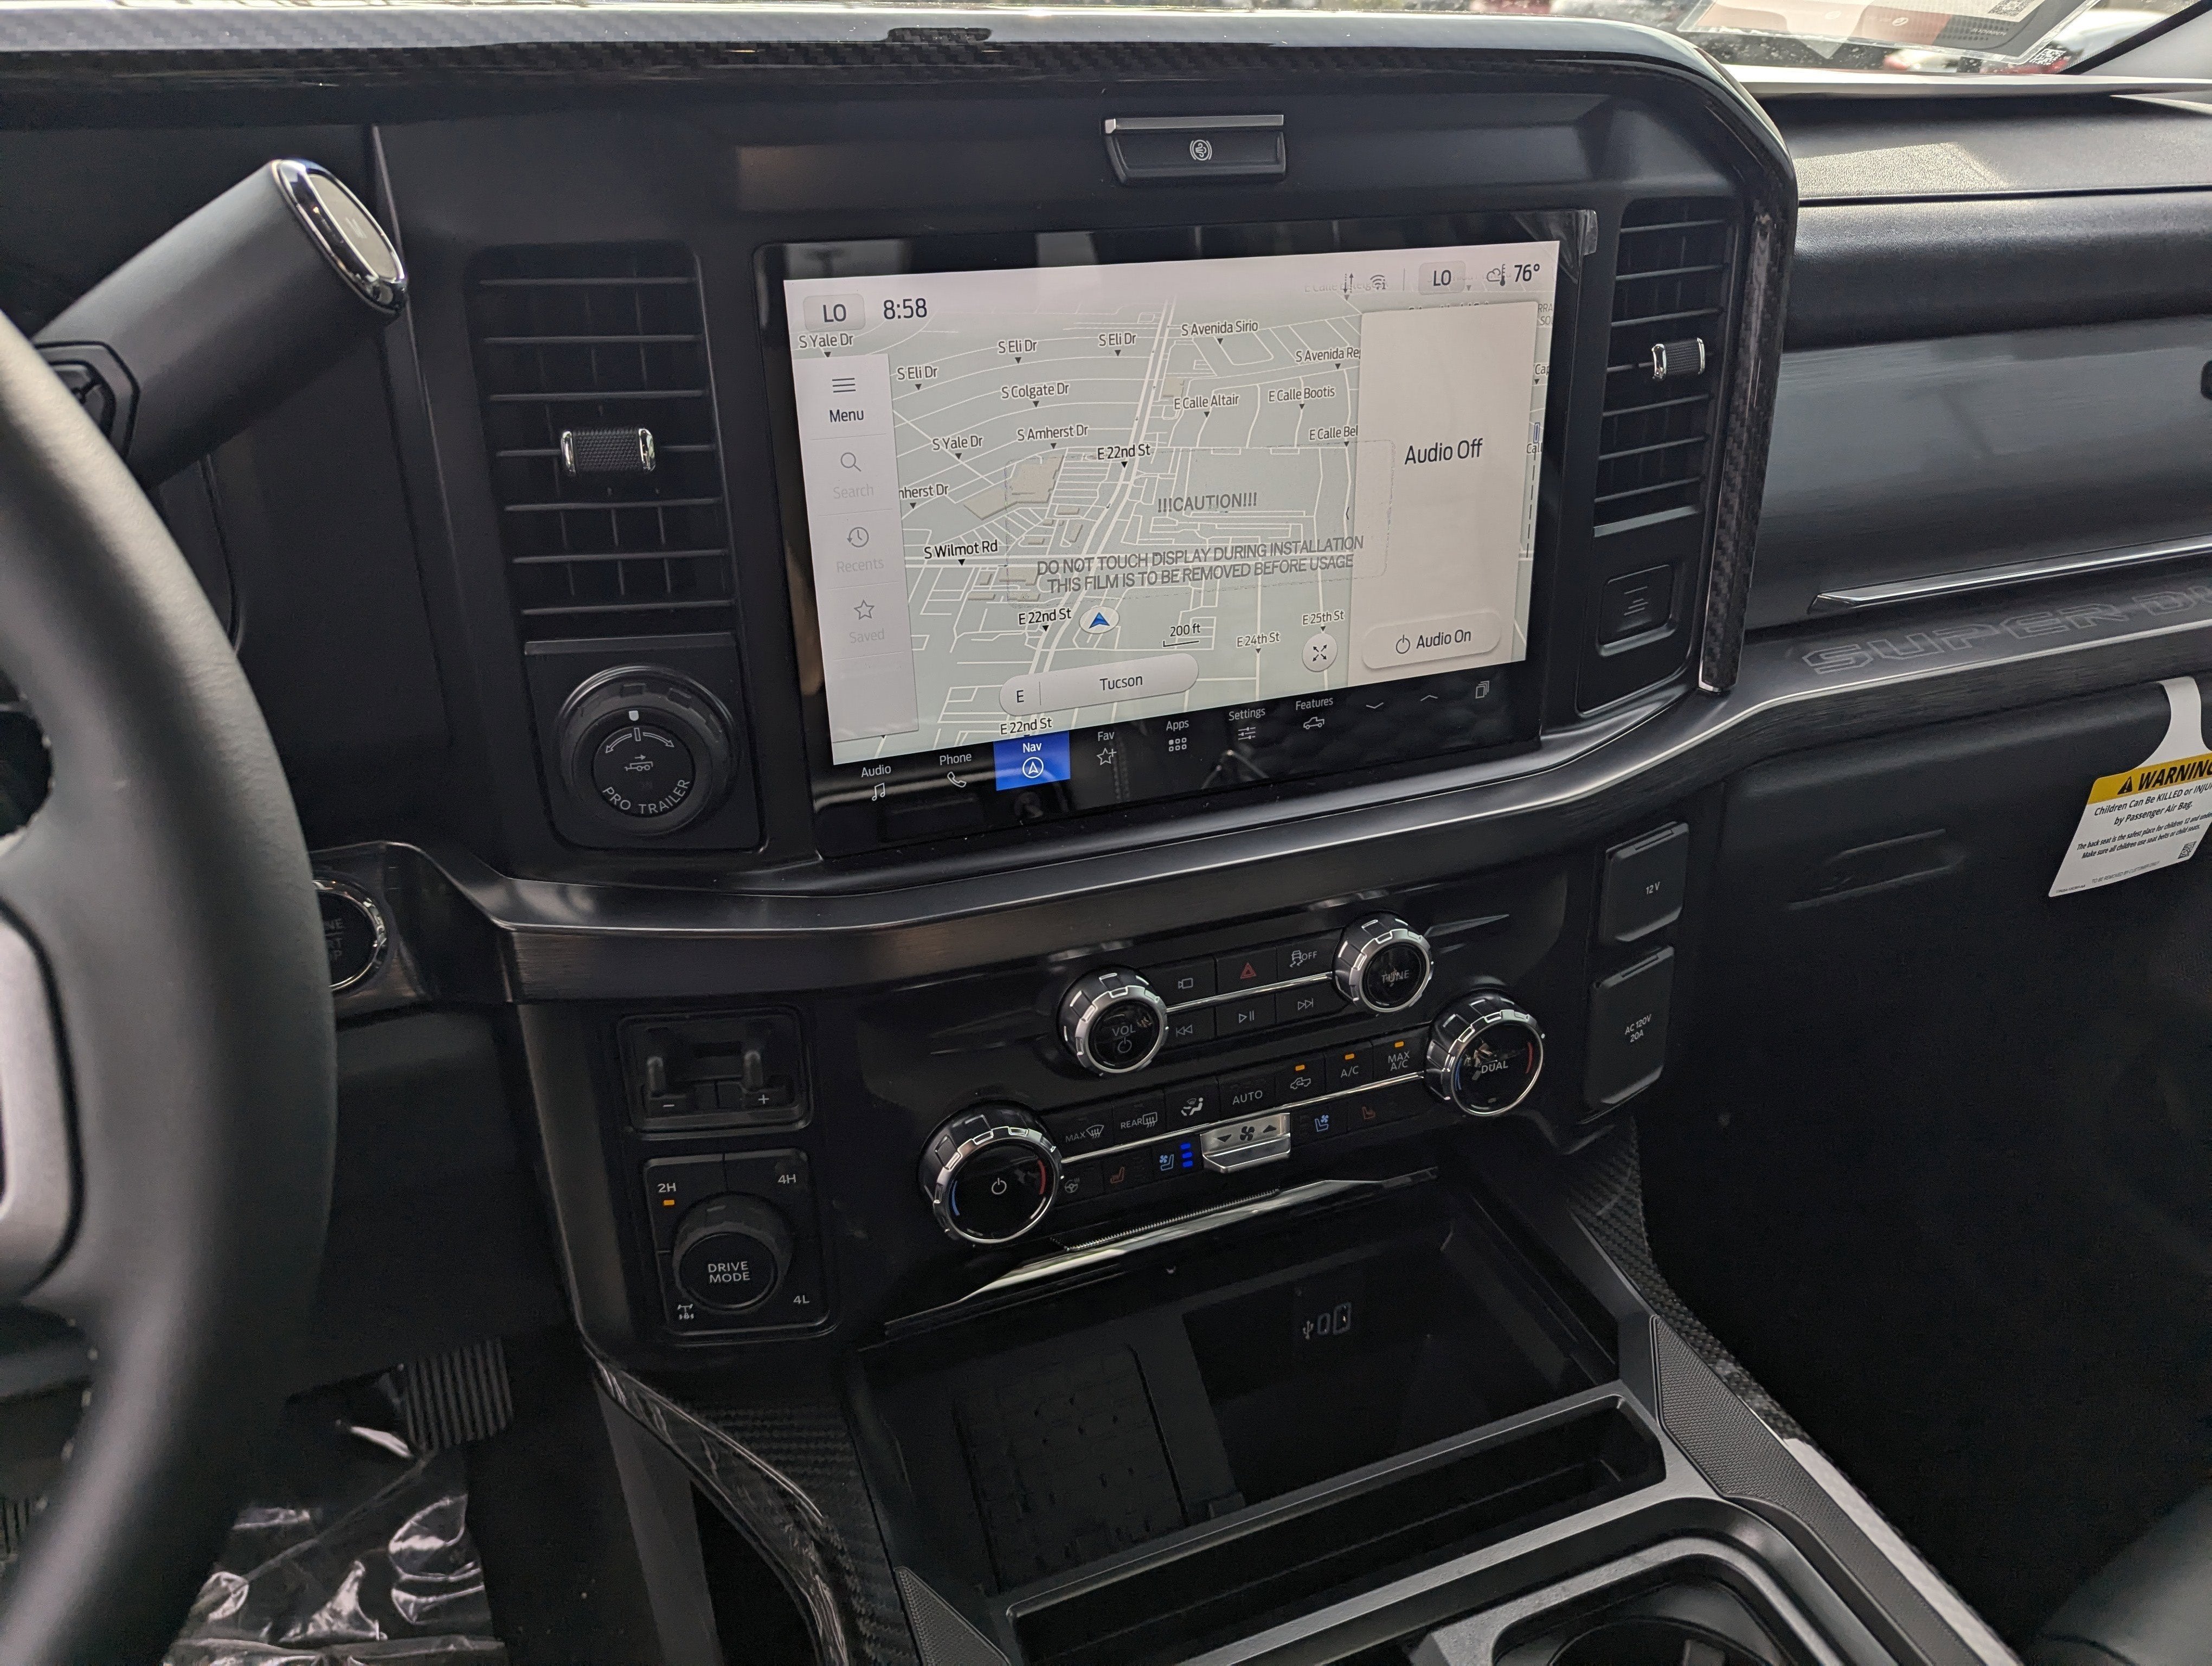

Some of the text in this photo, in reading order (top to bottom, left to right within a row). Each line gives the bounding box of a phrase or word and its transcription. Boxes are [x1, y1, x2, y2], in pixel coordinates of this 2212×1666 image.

[1433, 270, 1451, 286] LO
[824, 298, 927, 322] LO 8:58
[1181, 320, 1258, 336] S Avenida Sirio
[799, 334, 853, 348] S Yale Dr
[998, 339, 1037, 353] S Eli Dr
[1099, 332, 1136, 346] S Eli Dr
[1296, 351, 1302, 362] S
[1304, 348, 1344, 361] Avenida
[897, 366, 938, 380] S Eli Dr
[1001, 383, 1069, 400] S Colgate Dr
[1269, 386, 1335, 402] E Calle Bootis
[1174, 393, 1239, 410] E Calle Altair
[829, 409, 864, 422] Menu
[1018, 424, 1088, 440] S Amherst Dr
[1310, 430, 1315, 440] E
[1318, 427, 1341, 439] Calle
[933, 435, 982, 450] S Yale Dr
[1097, 444, 1150, 459] E 22nd St
[1405, 438, 1483, 465] Audio Off
[833, 484, 874, 499] Search
[936, 484, 948, 496] Dr
[925, 540, 998, 559] S Wilmot Rd
[1037, 535, 1364, 575] DO NOT TOUCH DISPLAY DURING INSTALLATION
[837, 558, 884, 573] Recents
[1047, 554, 1353, 593] THIS FILM IS TO BE REMOVED BEFORE USAGE
[1019, 608, 1071, 625] E 22nd St
[1302, 610, 1344, 625] E 25th St
[850, 629, 884, 643] Saved
[1169, 623, 1200, 637] 200 ft
[1237, 632, 1280, 647] E 24th St
[1416, 629, 1471, 649] Audio On
[1802, 603, 2129, 675] SUPER
[1017, 675, 1143, 703] E Tucson
[1296, 696, 1334, 710] Features
[1229, 707, 1265, 721] Settings
[1000, 717, 1052, 735] E 22nd St
[1166, 719, 1189, 732] Apps
[1097, 730, 1114, 741] Fav
[1023, 741, 1041, 753] Nav
[940, 752, 972, 766] Phone
[861, 764, 891, 778] Audio
[602, 779, 691, 814] PRO TRAILER
[2094, 803, 2127, 816] Children
[2129, 799, 2143, 809] Can
[2145, 796, 2155, 805] Be
[2157, 789, 2183, 802] KILLED
[2114, 817, 2123, 826] by
[2125, 808, 2164, 822] Passenger
[2165, 804, 2176, 813] Air
[2126, 831, 2141, 839] safest
[2142, 827, 2156, 837] place
[2164, 820, 2184, 830] children
[2190, 815, 2199, 823] and
[2081, 850, 2097, 858] Make
[2117, 841, 2137, 851] children
[2158, 832, 2169, 841] belts
[2176, 827, 2187, 836] child
[1301, 951, 1317, 961] OFF
[1112, 1024, 1136, 1036] VOL
[1625, 1014, 1652, 1035] AC 120V
[1630, 1029, 1644, 1043] 20A
[1387, 1052, 1410, 1063] MAX
[1340, 1066, 1359, 1079] A/C
[1390, 1059, 1409, 1072] A/C
[1481, 1060, 1508, 1074] DUAL
[1232, 1090, 1263, 1105] AUTO
[1121, 1118, 1142, 1129] REAR
[1065, 1131, 1085, 1143] MAX
[777, 1174, 796, 1184] 4H
[657, 1183, 677, 1193] 2H
[708, 1261, 748, 1272] DRIVE
[709, 1271, 751, 1283] MODE
[793, 1295, 810, 1304] 4L
